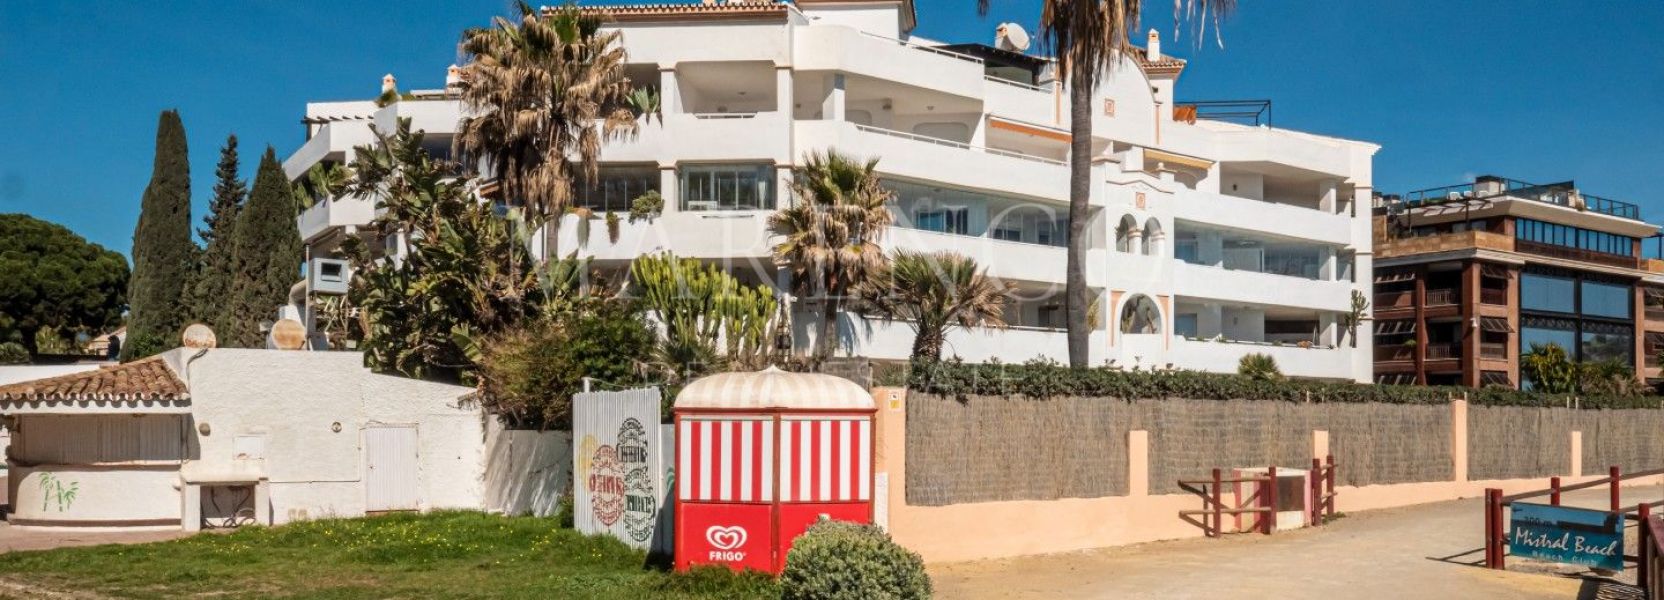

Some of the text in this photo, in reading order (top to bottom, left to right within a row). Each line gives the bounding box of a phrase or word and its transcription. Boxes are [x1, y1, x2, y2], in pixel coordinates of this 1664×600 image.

[1515, 526, 1618, 556] Mistral Beach
[708, 550, 744, 562] FRIGO
